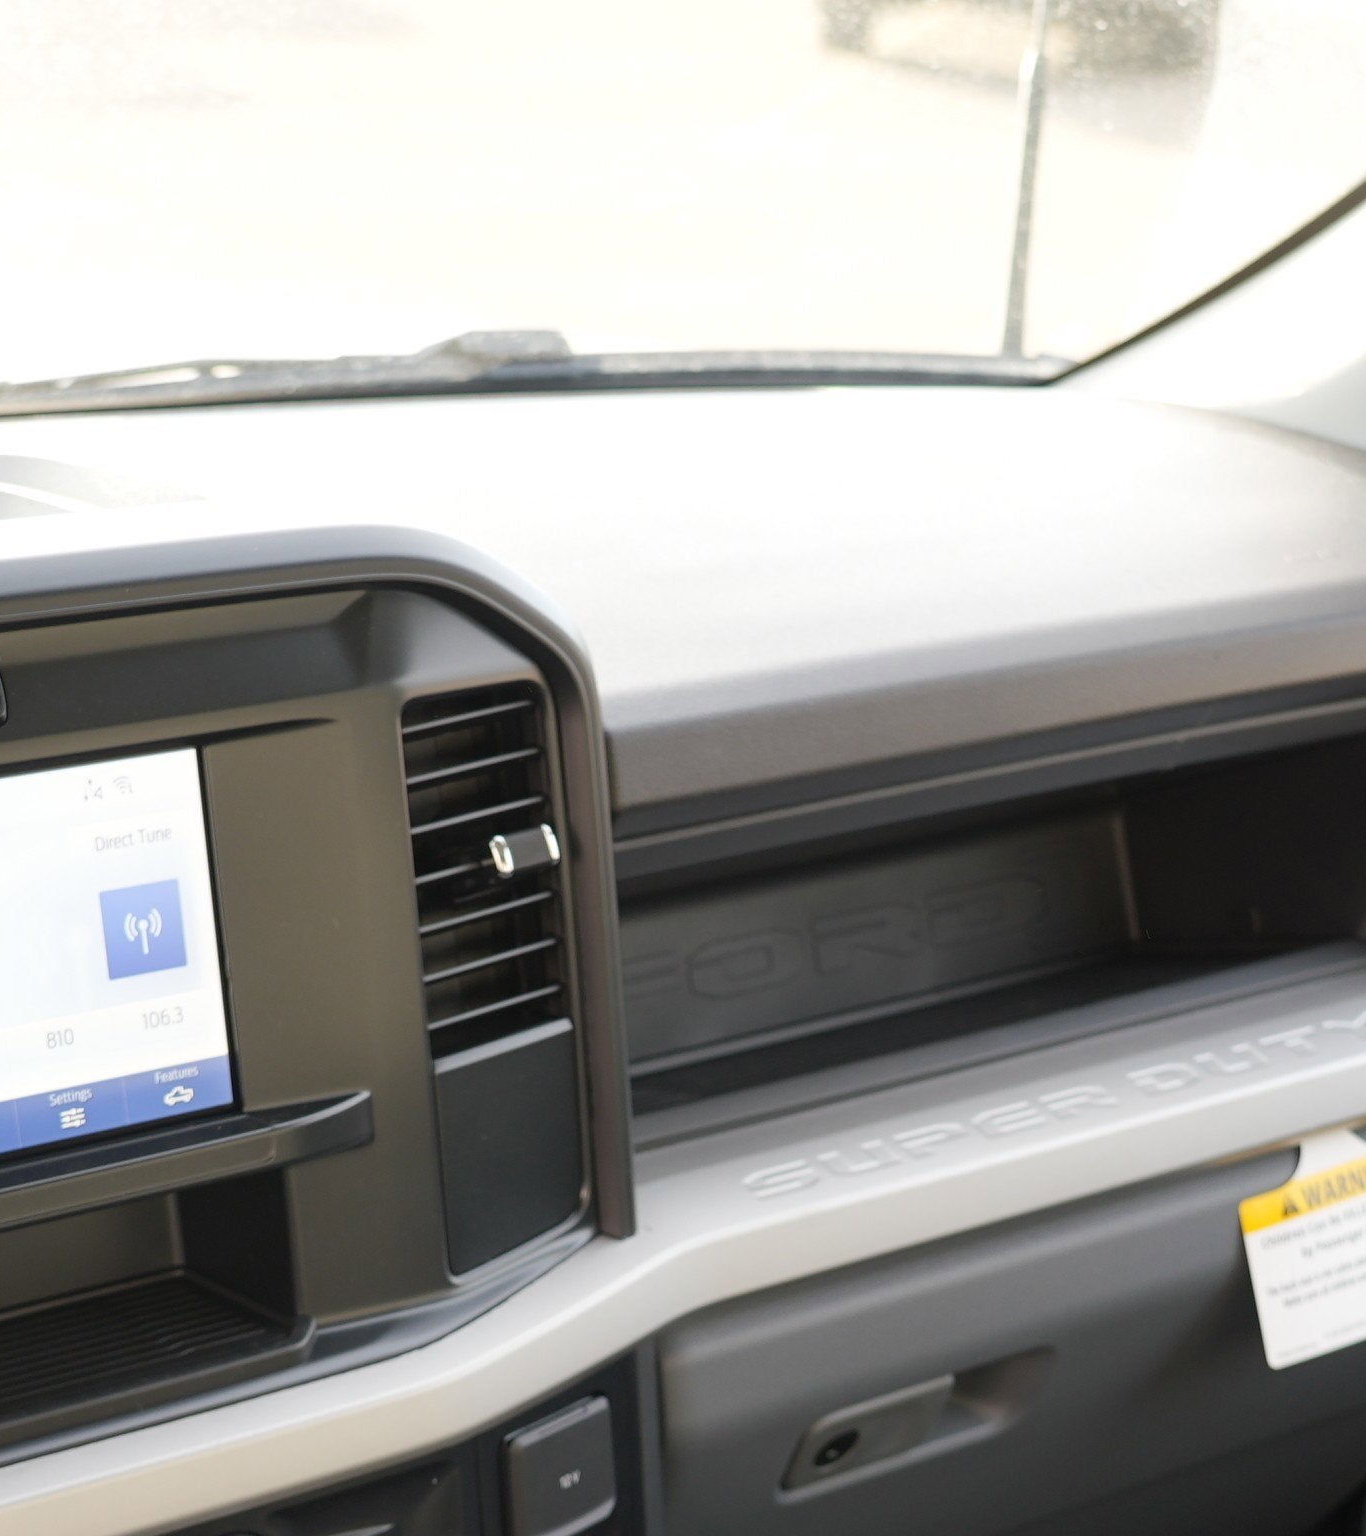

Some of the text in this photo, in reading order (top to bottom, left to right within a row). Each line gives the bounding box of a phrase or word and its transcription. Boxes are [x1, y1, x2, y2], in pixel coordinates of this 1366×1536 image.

[94, 828, 172, 852] Direct Tune
[46, 1028, 75, 1050] 810
[142, 1006, 184, 1029] 106.3
[154, 1065, 199, 1084] Features
[49, 1088, 93, 1107] Settings
[742, 1084, 1118, 1200] SUPER
